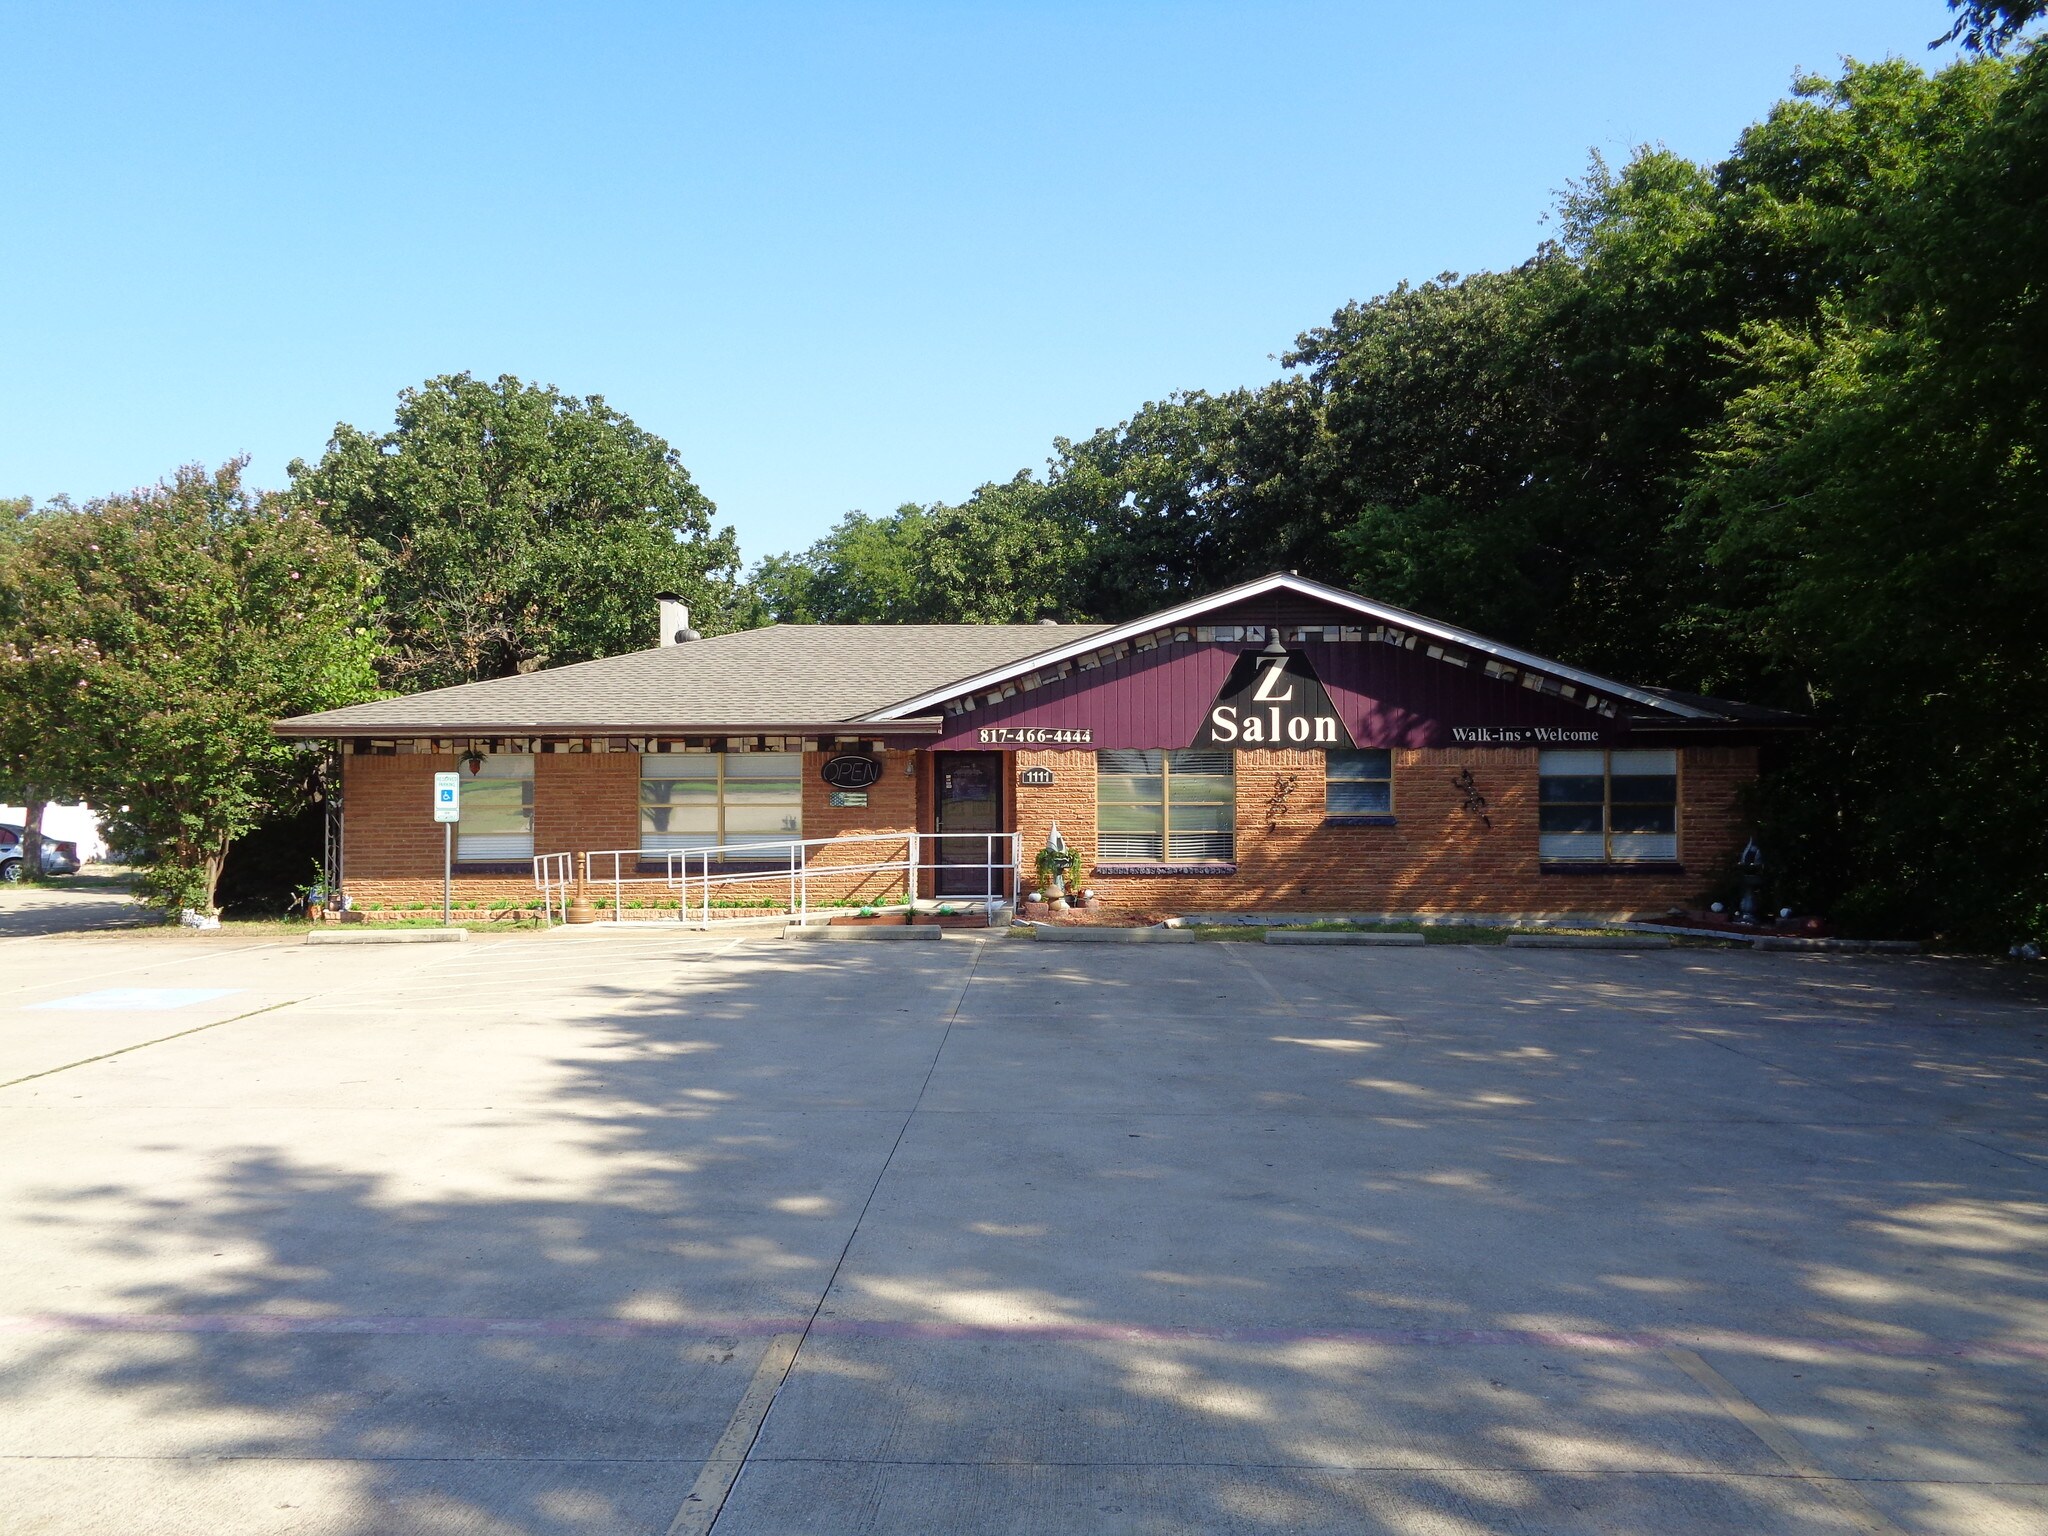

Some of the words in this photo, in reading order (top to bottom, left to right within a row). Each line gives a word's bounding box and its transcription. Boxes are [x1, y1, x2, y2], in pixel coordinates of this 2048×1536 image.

[1253, 656, 1293, 701] Z
[1211, 706, 1338, 742] Salon
[980, 729, 1091, 743] 817-466-4444
[1452, 728, 1521, 741] Walk-ins
[1534, 728, 1599, 741] Welcome
[823, 763, 879, 781] OPEN
[1027, 771, 1049, 782] 1111
